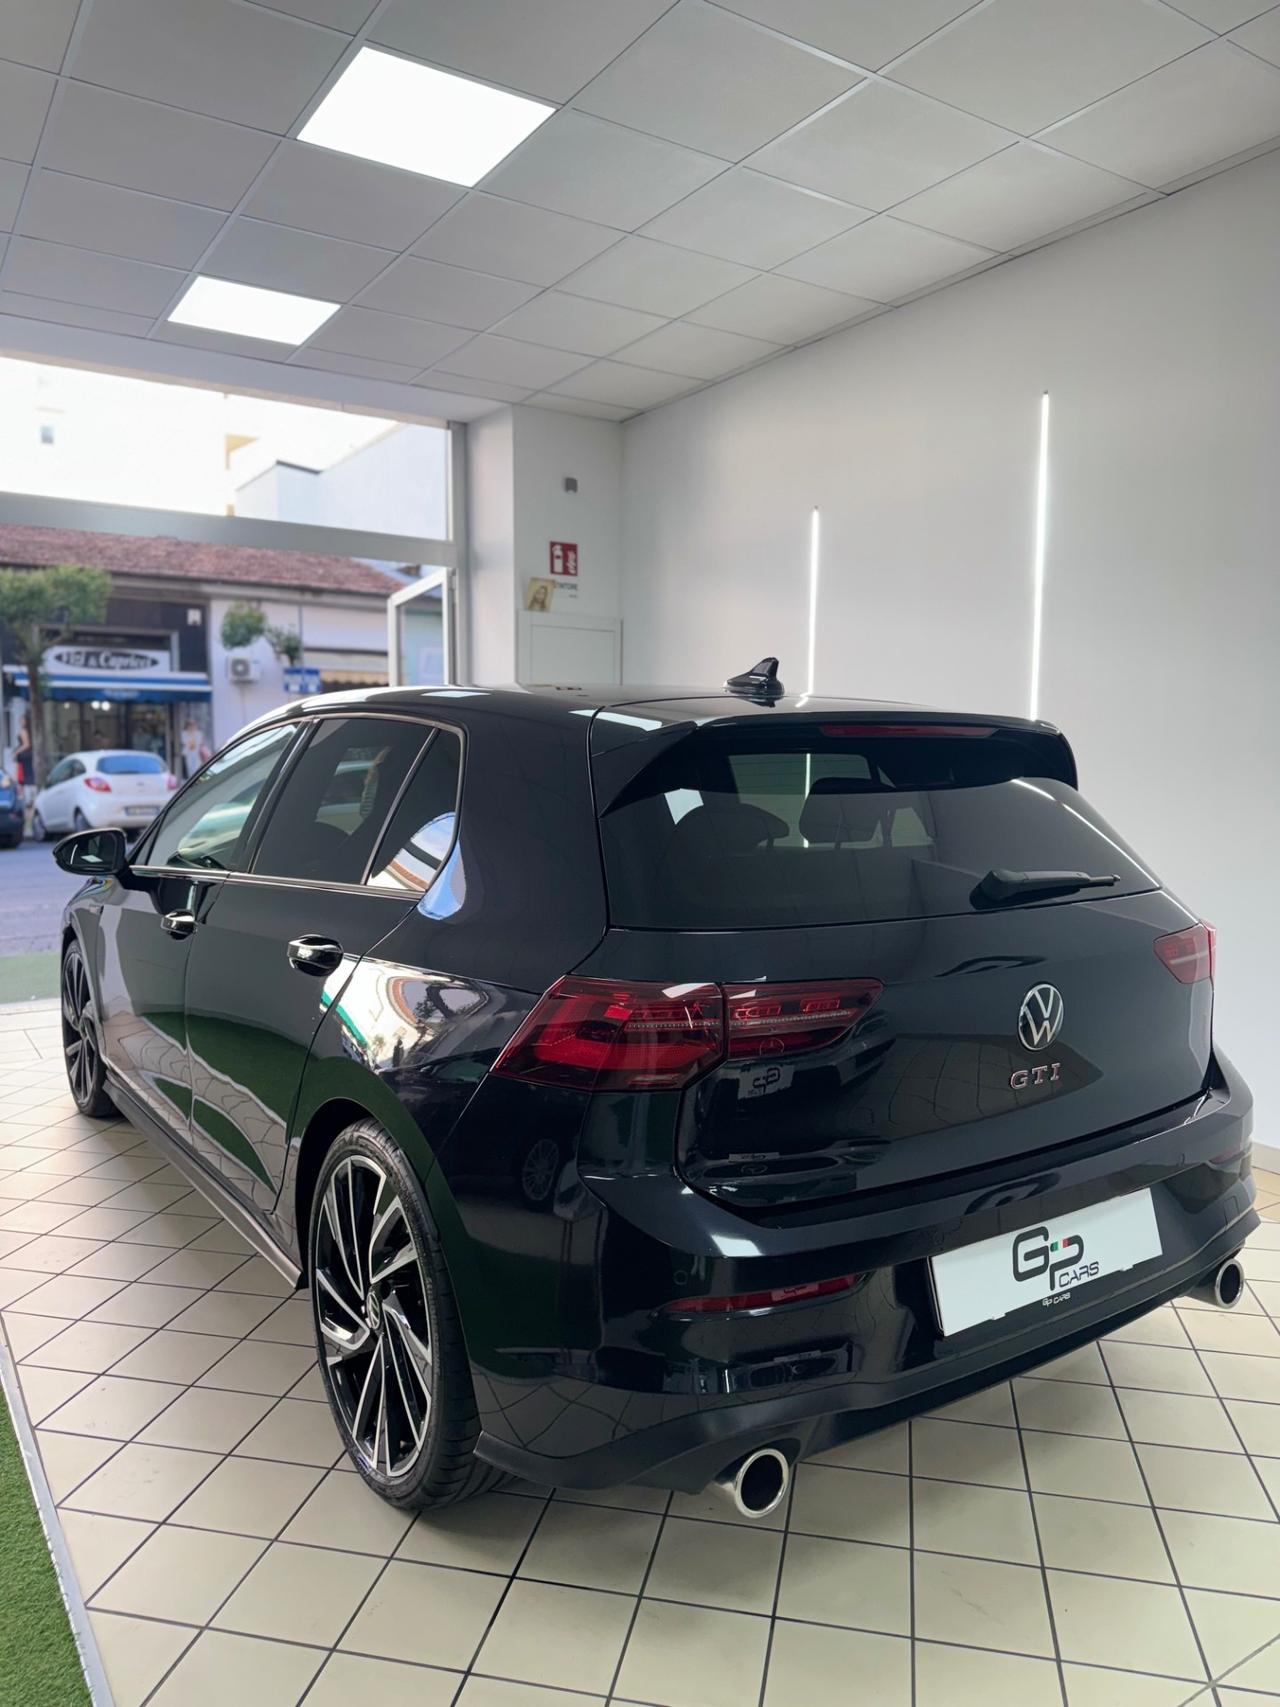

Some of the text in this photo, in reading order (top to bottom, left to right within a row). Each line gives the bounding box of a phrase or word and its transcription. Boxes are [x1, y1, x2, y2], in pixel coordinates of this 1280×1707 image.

[1010, 1062, 1060, 1089] GTI
[1013, 1226, 1084, 1291] GP
[1059, 1261, 1099, 1287] CARS
[1054, 1292, 1071, 1304] CARS
